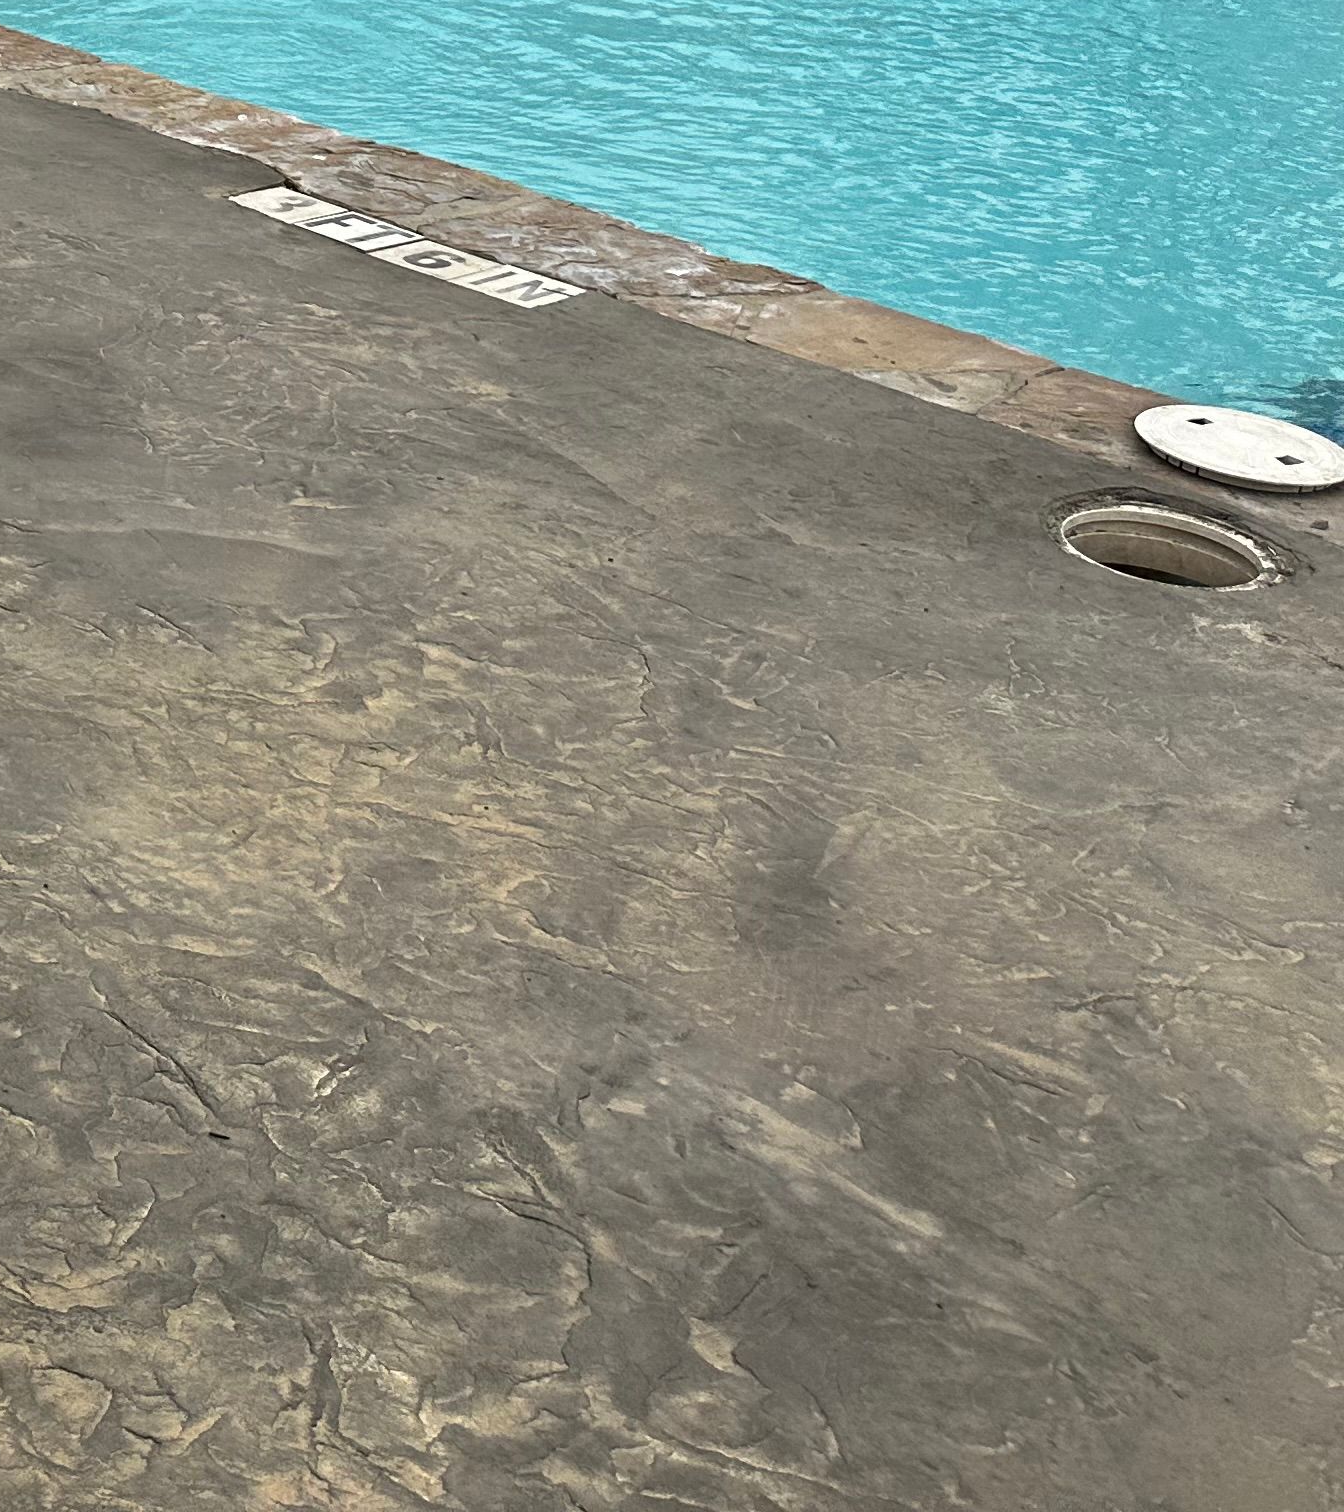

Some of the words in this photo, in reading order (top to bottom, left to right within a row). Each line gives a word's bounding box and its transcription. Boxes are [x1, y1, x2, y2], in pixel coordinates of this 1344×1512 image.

[263, 194, 317, 214] 3
[305, 213, 416, 243] FT
[402, 250, 466, 270] 6
[471, 271, 567, 303] IN
